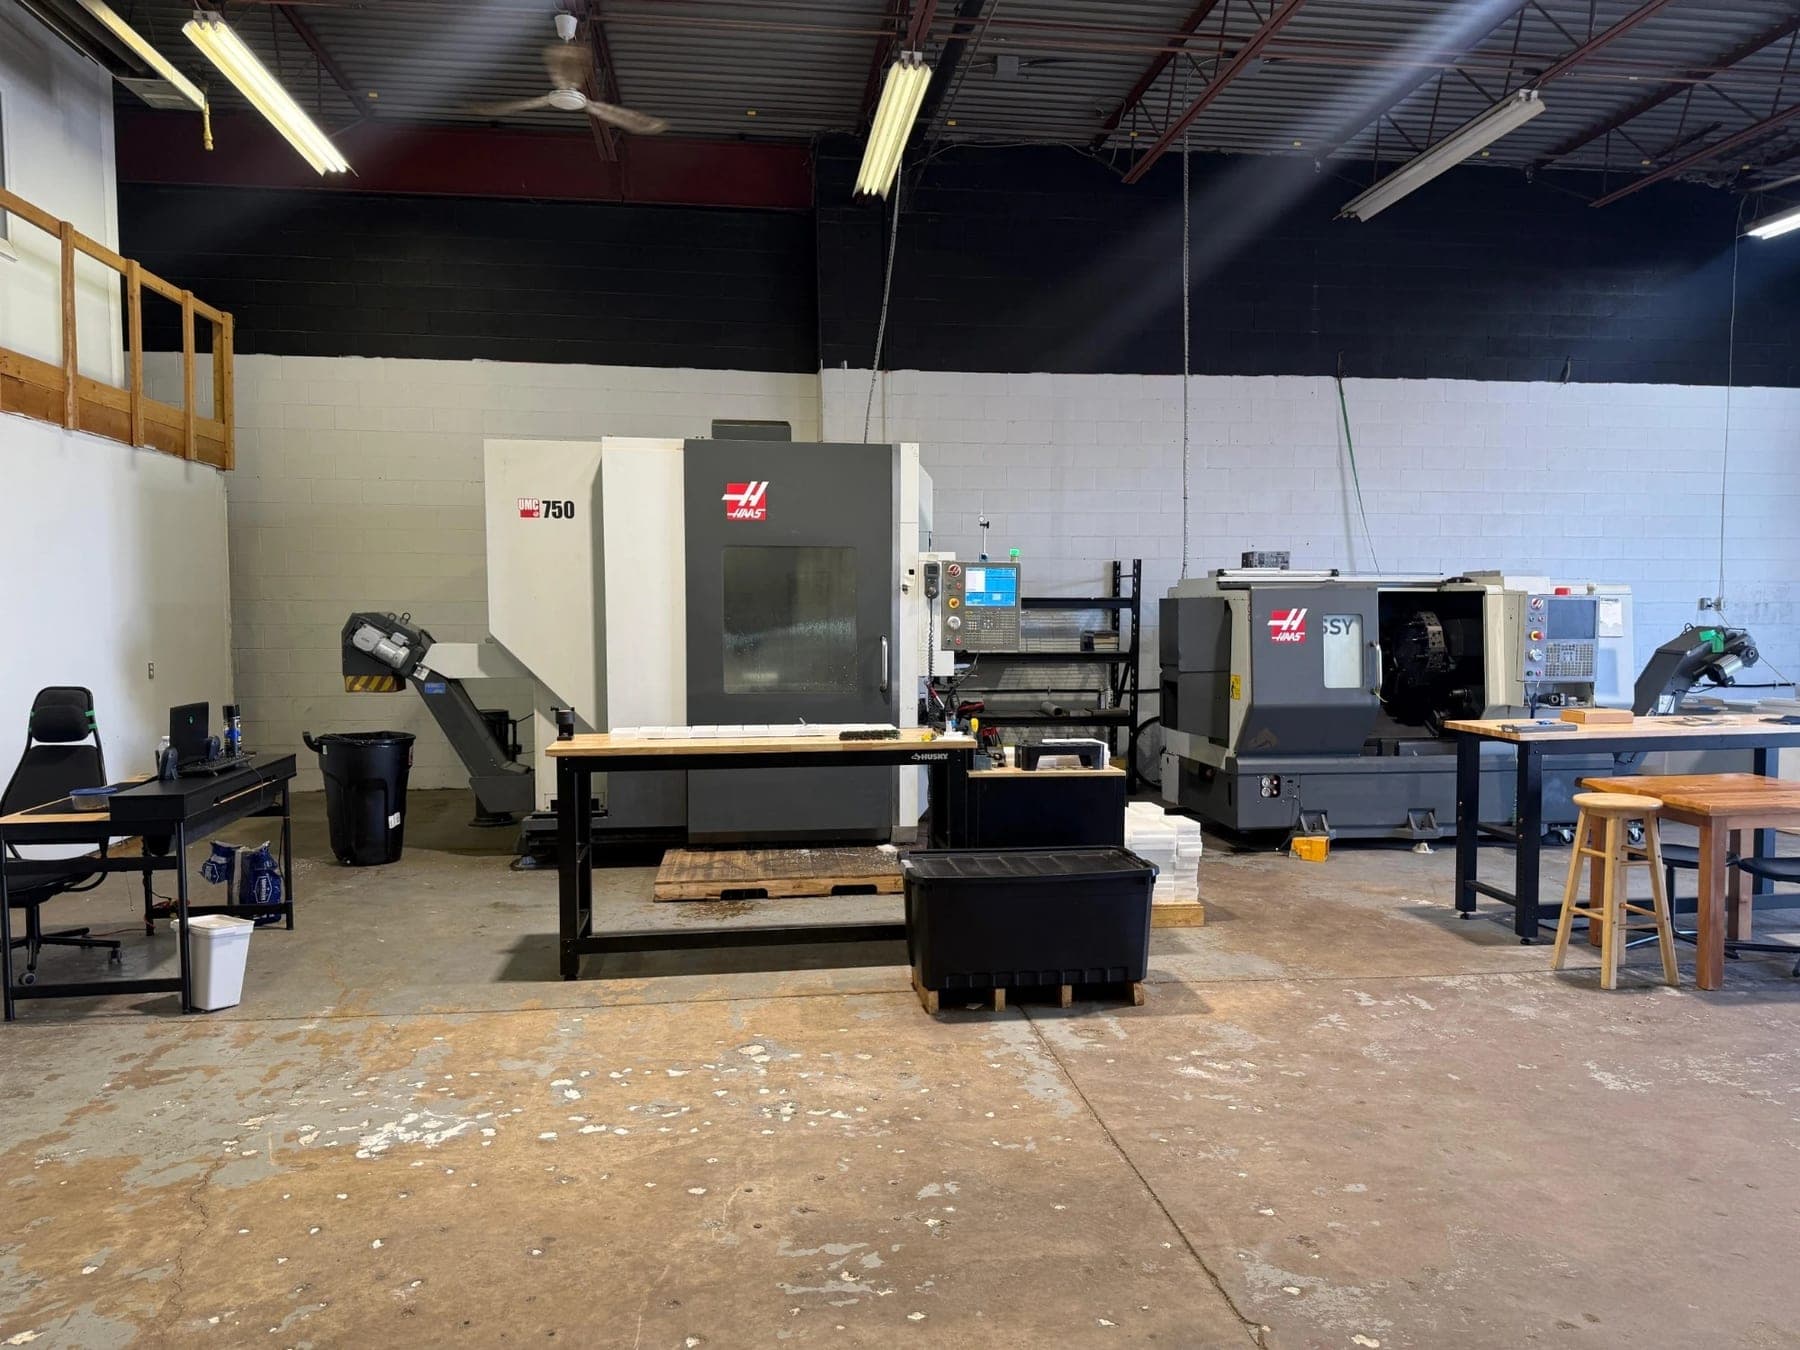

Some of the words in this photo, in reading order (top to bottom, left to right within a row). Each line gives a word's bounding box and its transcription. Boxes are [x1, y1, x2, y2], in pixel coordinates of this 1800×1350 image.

[518, 499, 539, 511] UMC
[542, 500, 575, 519] 750
[727, 508, 766, 519] HAAS
[1272, 632, 1305, 642] HAAS
